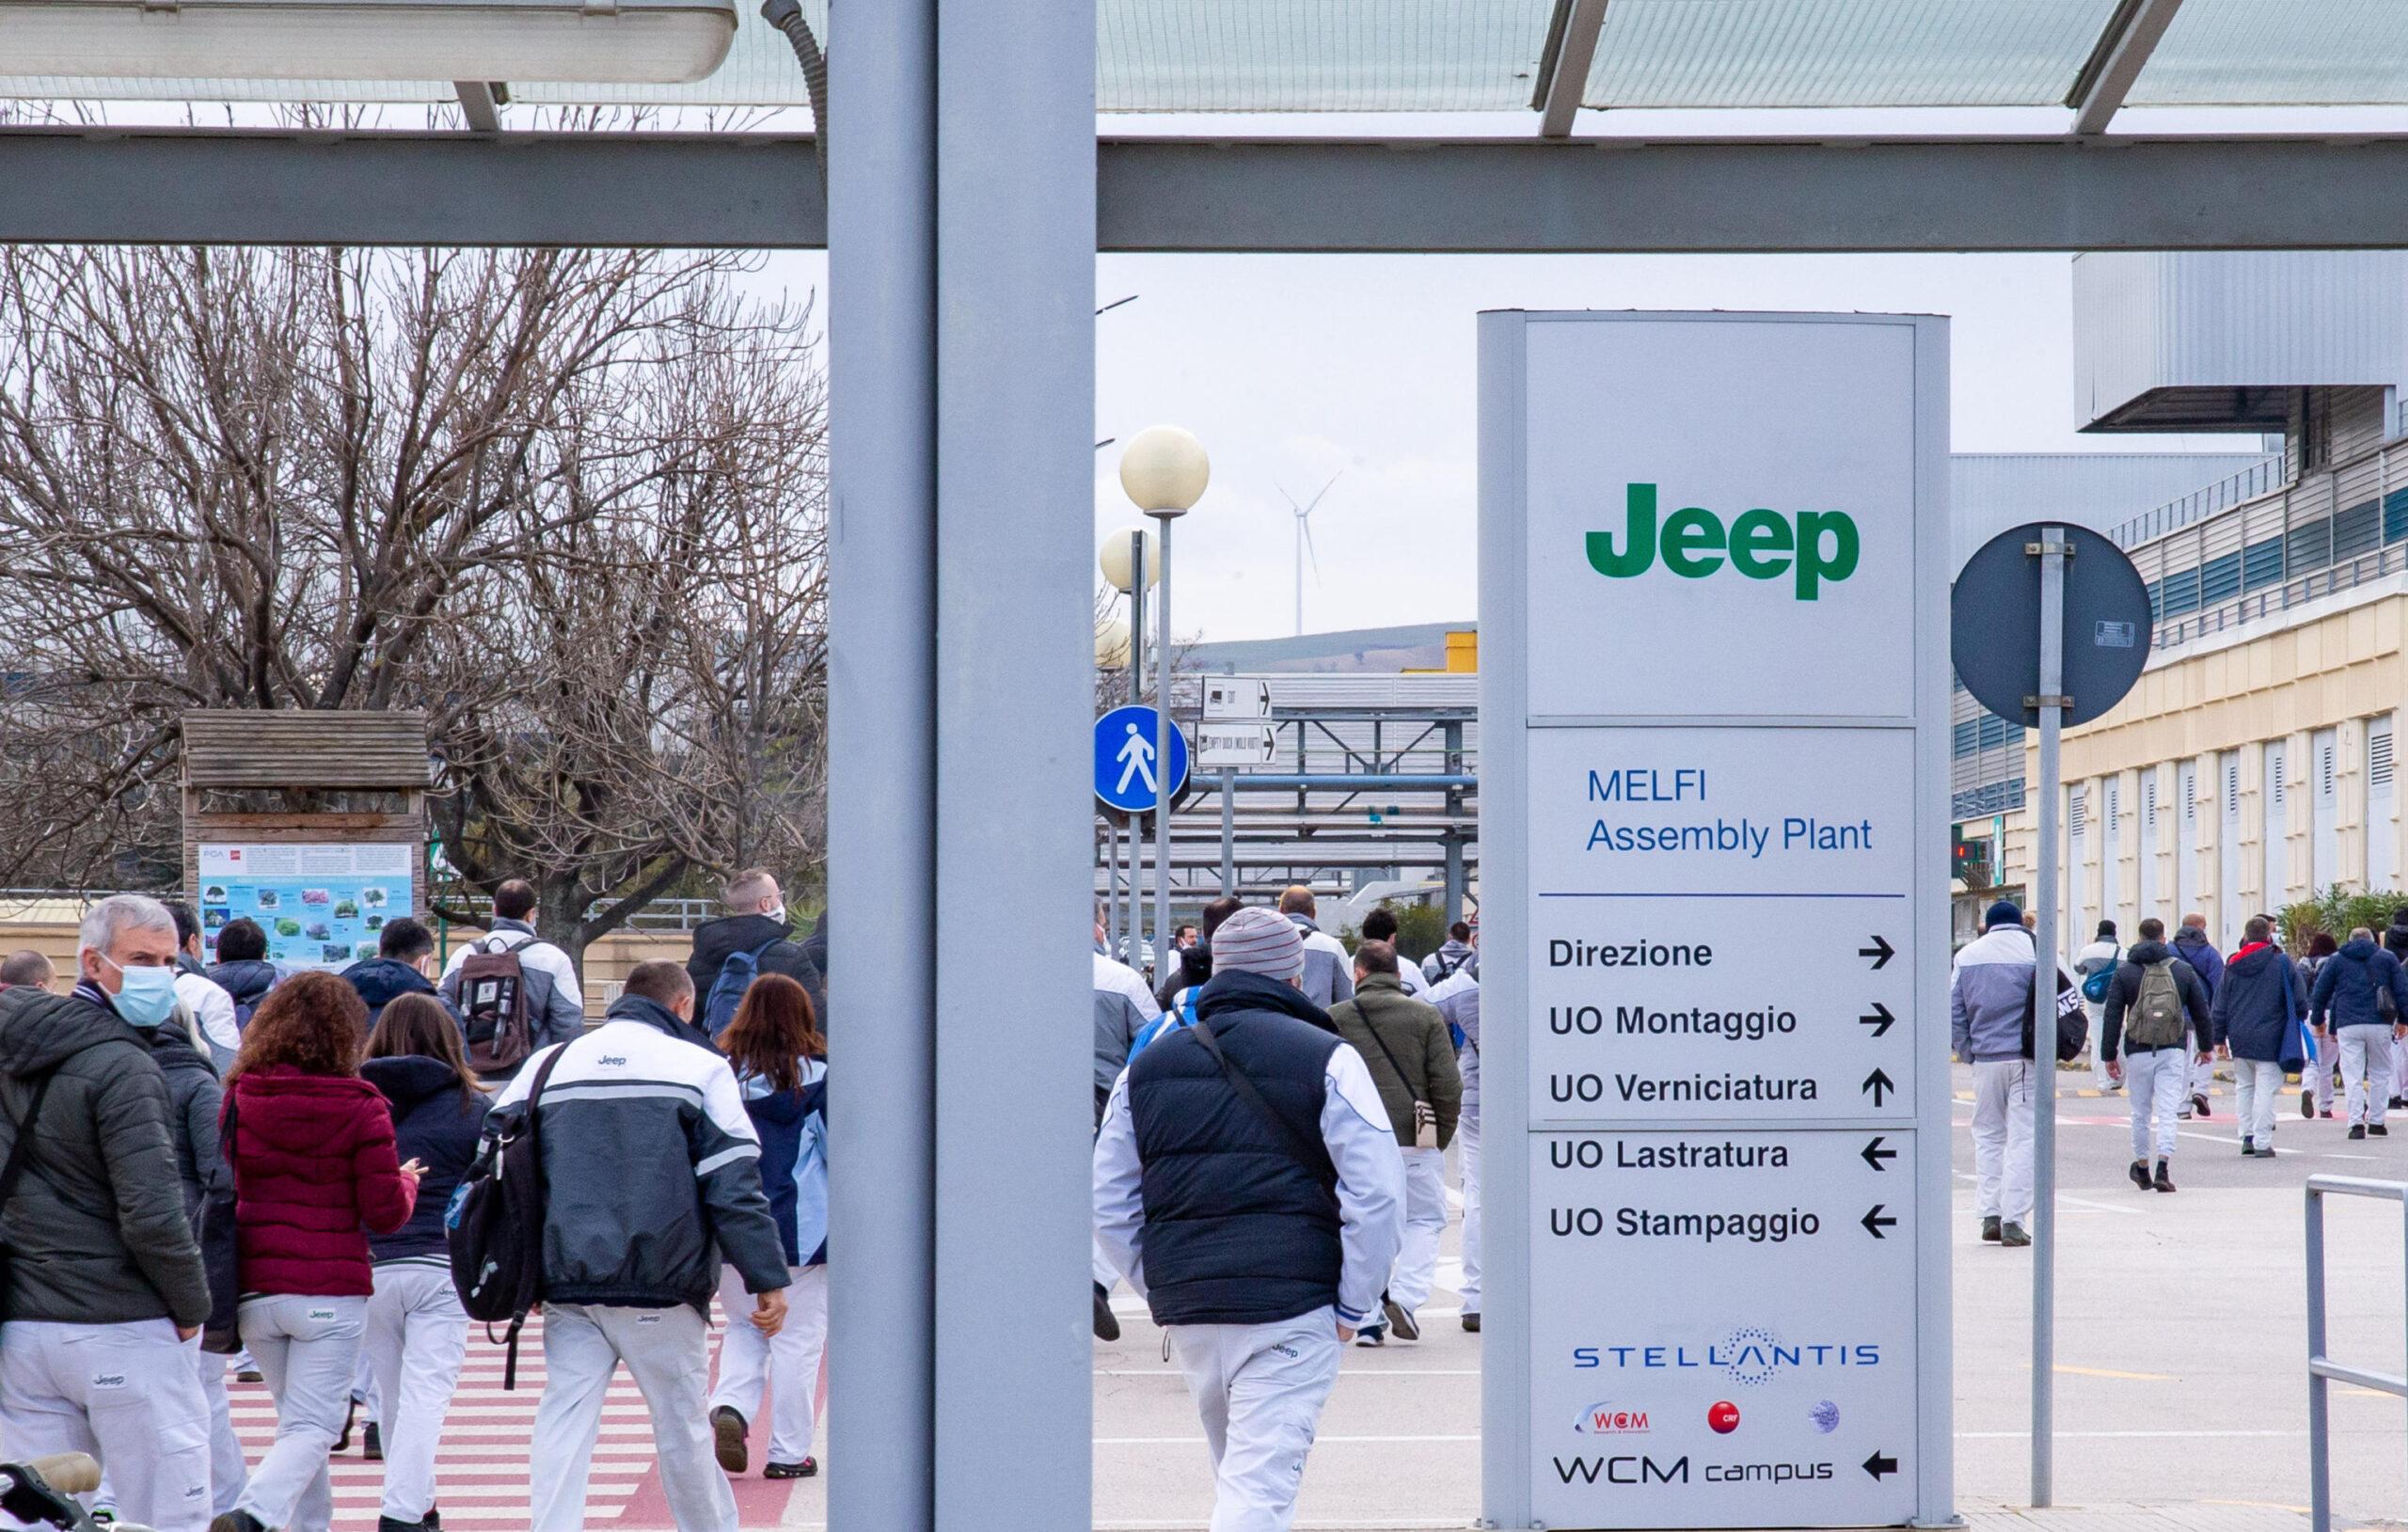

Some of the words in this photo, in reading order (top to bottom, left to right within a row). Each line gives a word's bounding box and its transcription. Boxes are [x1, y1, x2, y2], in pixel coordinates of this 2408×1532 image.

[1586, 483, 1860, 601] Jeep
[1589, 768, 1705, 802] MELFI
[1586, 818, 1770, 860] Assembly
[1783, 817, 1873, 850] Plant
[1549, 939, 1713, 968] Direzione
[1549, 1006, 1603, 1035] UO
[1616, 1005, 1797, 1041] Montaggio
[597, 1054, 627, 1067] Jeep
[1550, 1074, 1604, 1102] UO
[1615, 1072, 1818, 1102] Verniciatura
[1550, 1140, 1604, 1169] UO
[1617, 1140, 1789, 1169] Lastratura
[1550, 1207, 1604, 1237] UO
[1616, 1207, 1820, 1243] Stampaggio
[309, 1310, 335, 1319] Jeep
[1271, 1343, 1299, 1359] Jeep
[1573, 1345, 1879, 1367] STELLANTIS
[93, 1374, 124, 1385] Jeep
[1593, 1412, 1649, 1429] WCM
[1552, 1455, 1689, 1485] WCM
[1704, 1462, 1833, 1485] campus
